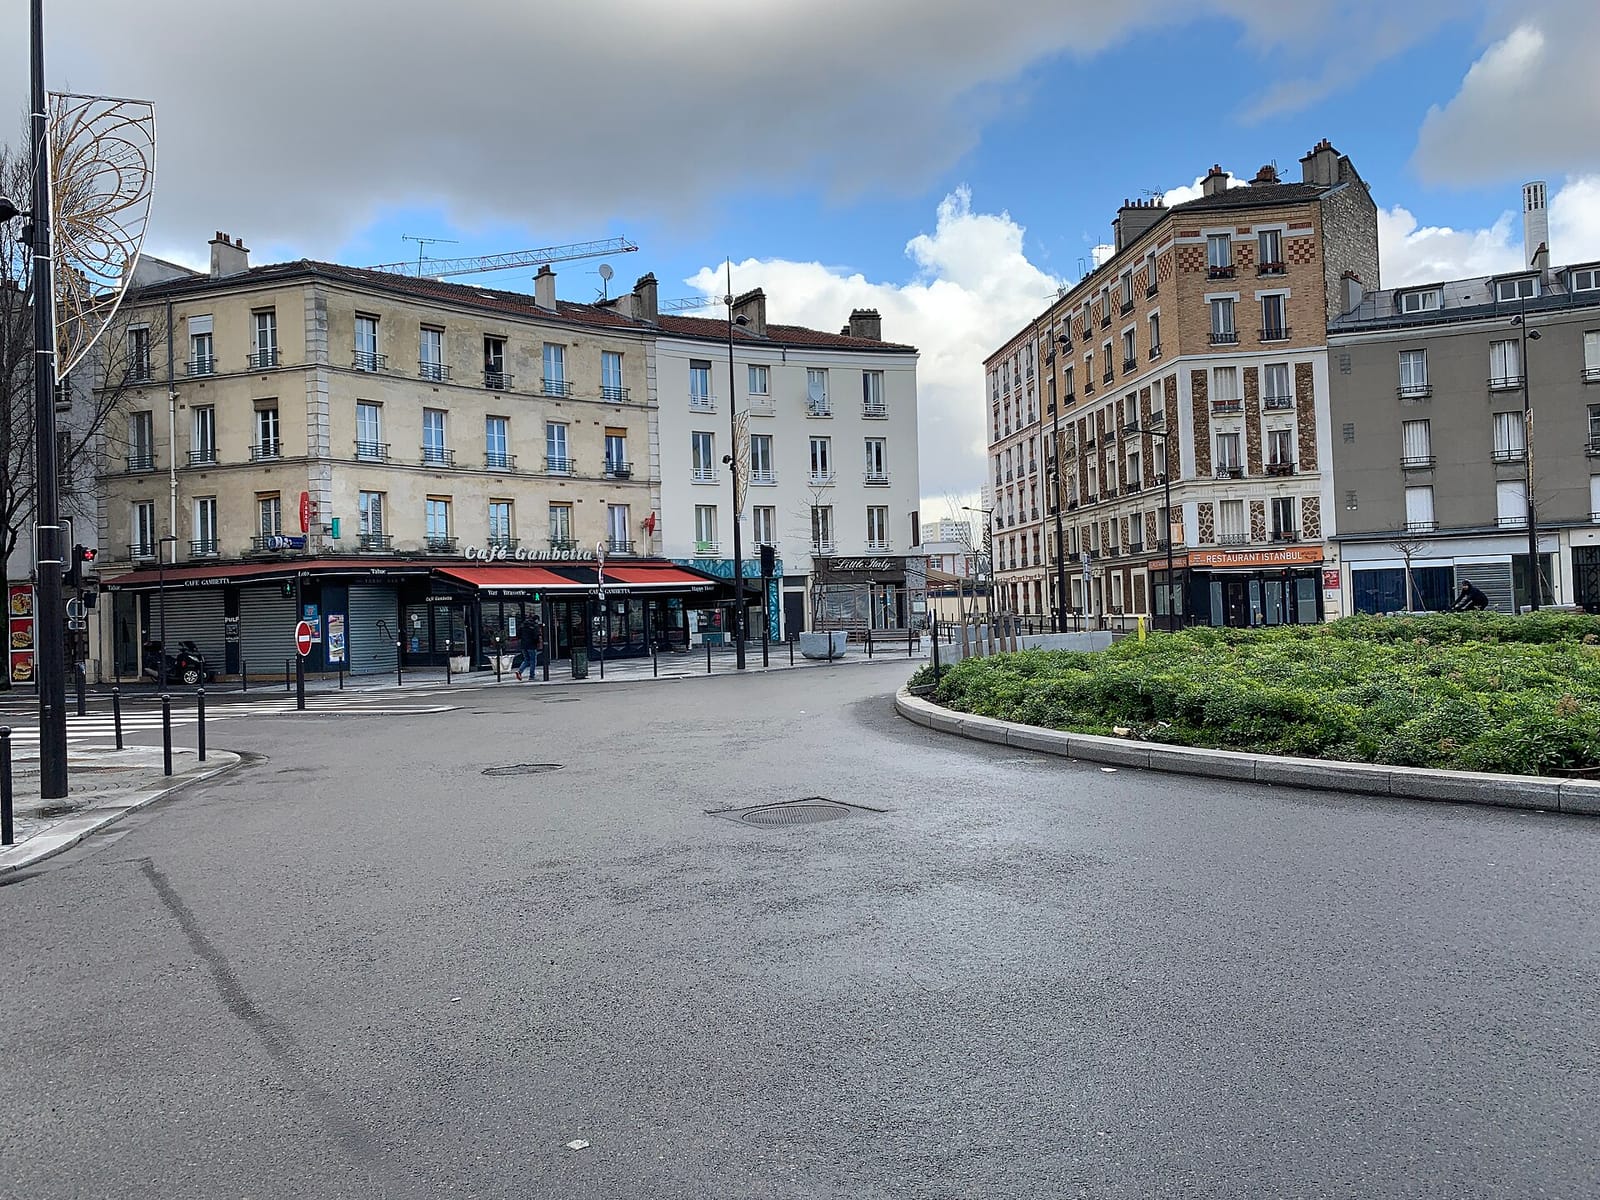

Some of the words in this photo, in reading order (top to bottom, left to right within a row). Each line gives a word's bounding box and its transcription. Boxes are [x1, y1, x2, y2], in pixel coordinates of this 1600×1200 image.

[464, 545, 508, 562] Café
[514, 546, 593, 561] Gambetta
[1206, 553, 1260, 563] RESTAURANT
[1261, 551, 1303, 561] ISTANBUL
[834, 558, 864, 569] Little
[864, 558, 892, 571] Italy
[201, 577, 230, 586] GAMBETTA
